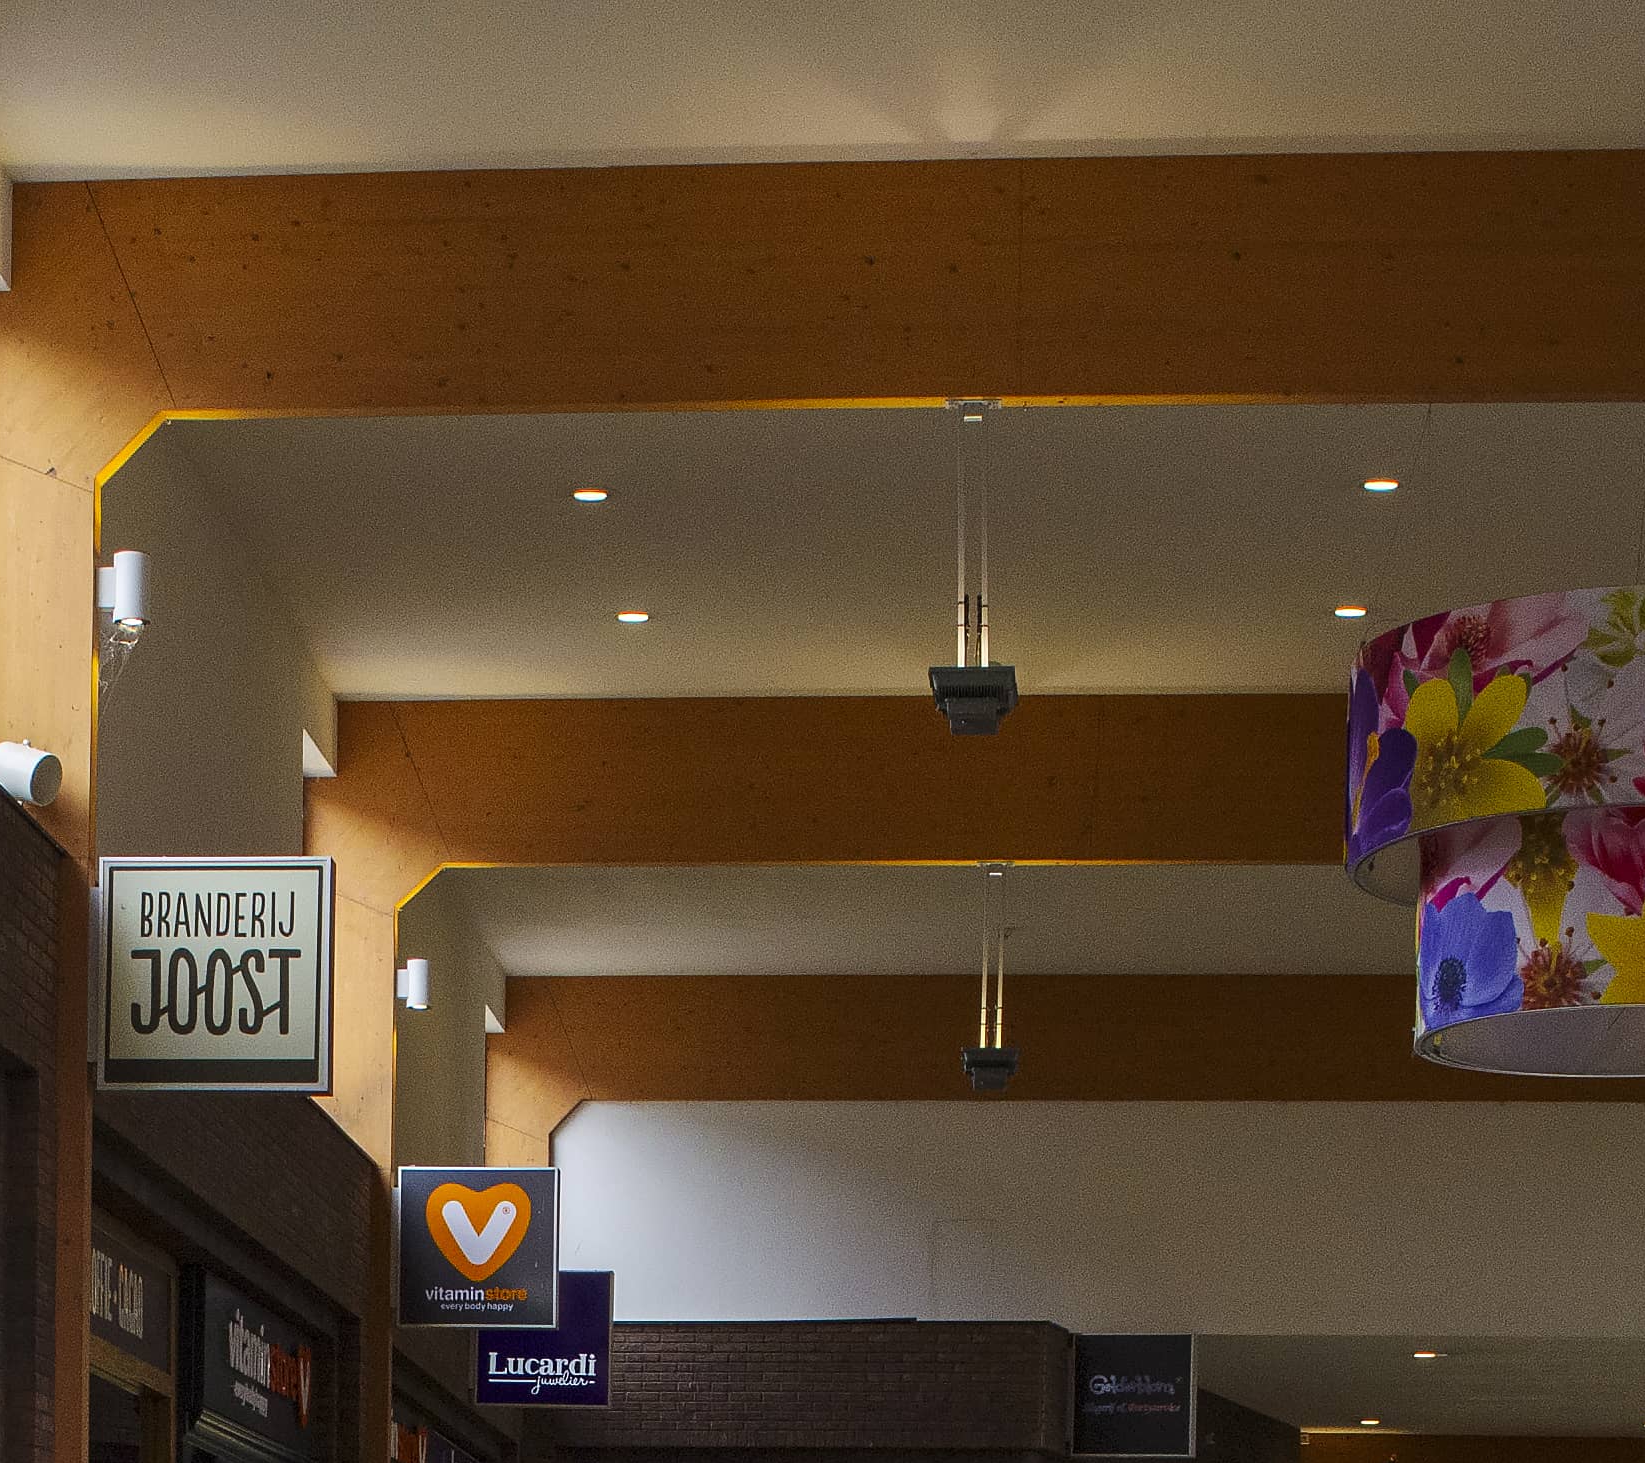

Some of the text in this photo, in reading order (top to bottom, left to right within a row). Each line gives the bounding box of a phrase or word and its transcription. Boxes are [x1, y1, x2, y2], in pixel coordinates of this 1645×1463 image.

[140, 891, 295, 938] BRANDERIJ
[130, 948, 302, 1036] JOOST
[425, 1286, 528, 1301] vitaminstore
[440, 1302, 514, 1312] every body happy
[488, 1351, 597, 1377] Lucardi
[531, 1369, 589, 1395] juwelier
